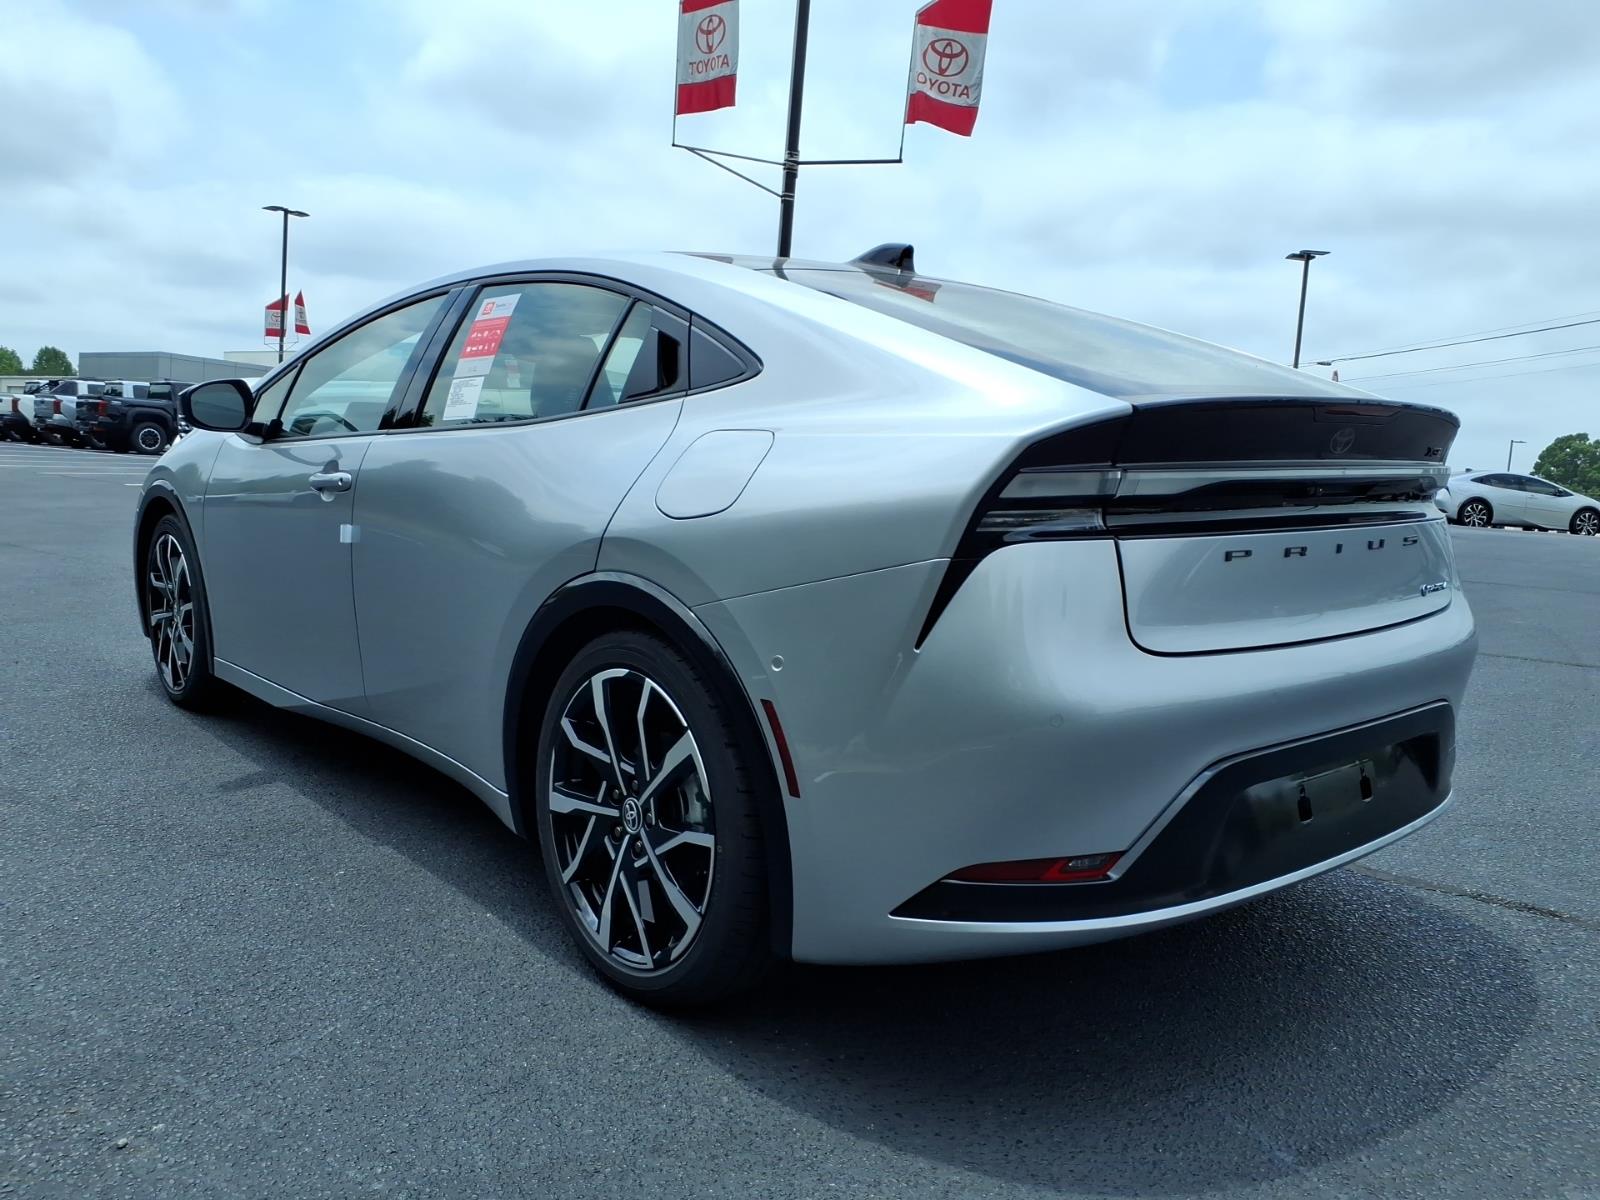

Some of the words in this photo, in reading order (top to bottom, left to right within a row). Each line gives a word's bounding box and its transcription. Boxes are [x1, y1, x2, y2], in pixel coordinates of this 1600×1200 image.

[689, 54, 729, 75] TOYOTA
[917, 72, 970, 99] OYOTA
[1224, 536, 1418, 562] PRIUS
